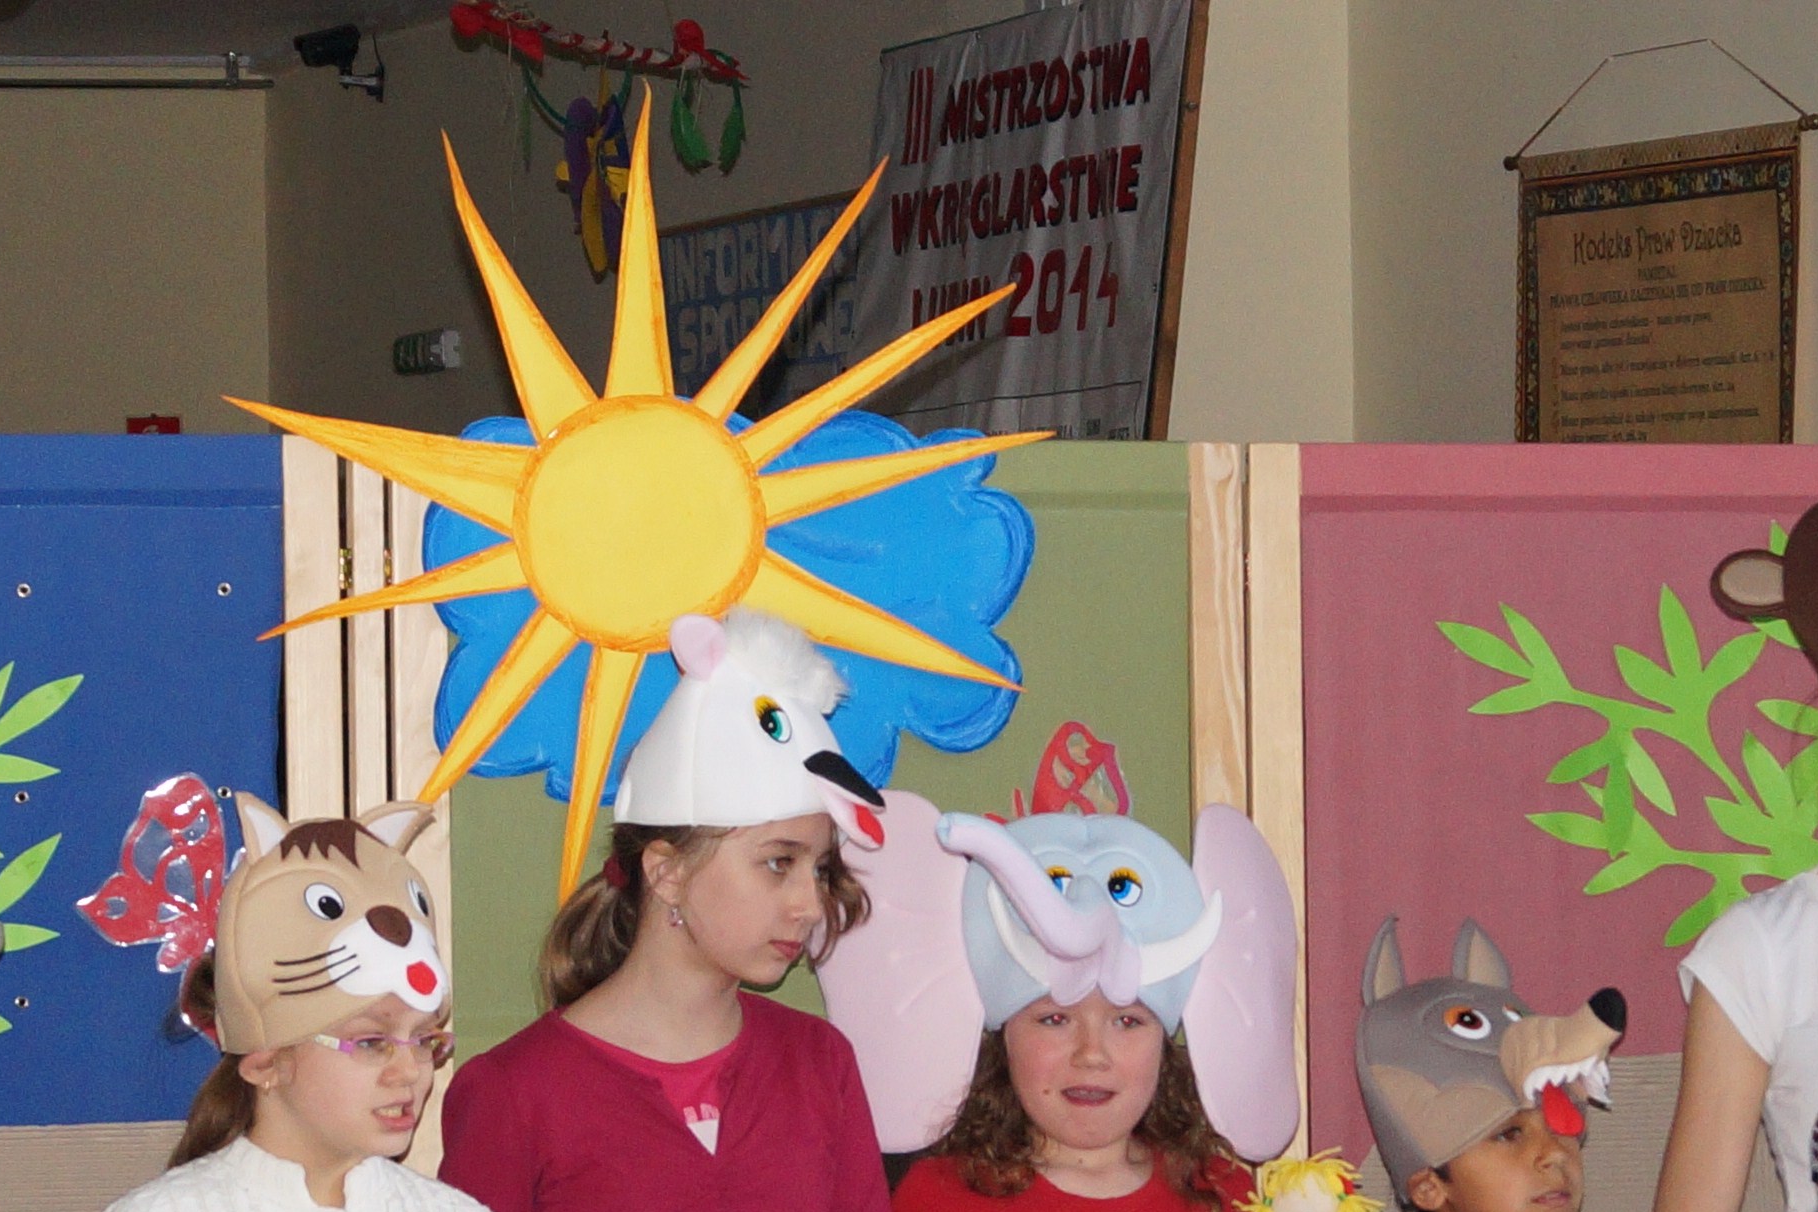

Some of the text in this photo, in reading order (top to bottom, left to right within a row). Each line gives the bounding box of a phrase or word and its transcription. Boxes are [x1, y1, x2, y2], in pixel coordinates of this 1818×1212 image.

[903, 37, 1151, 165] III MISTRZOSTWA
[1004, 241, 1120, 337] 2014
[1573, 219, 1743, 266] Kodeks Praw Dziecka
